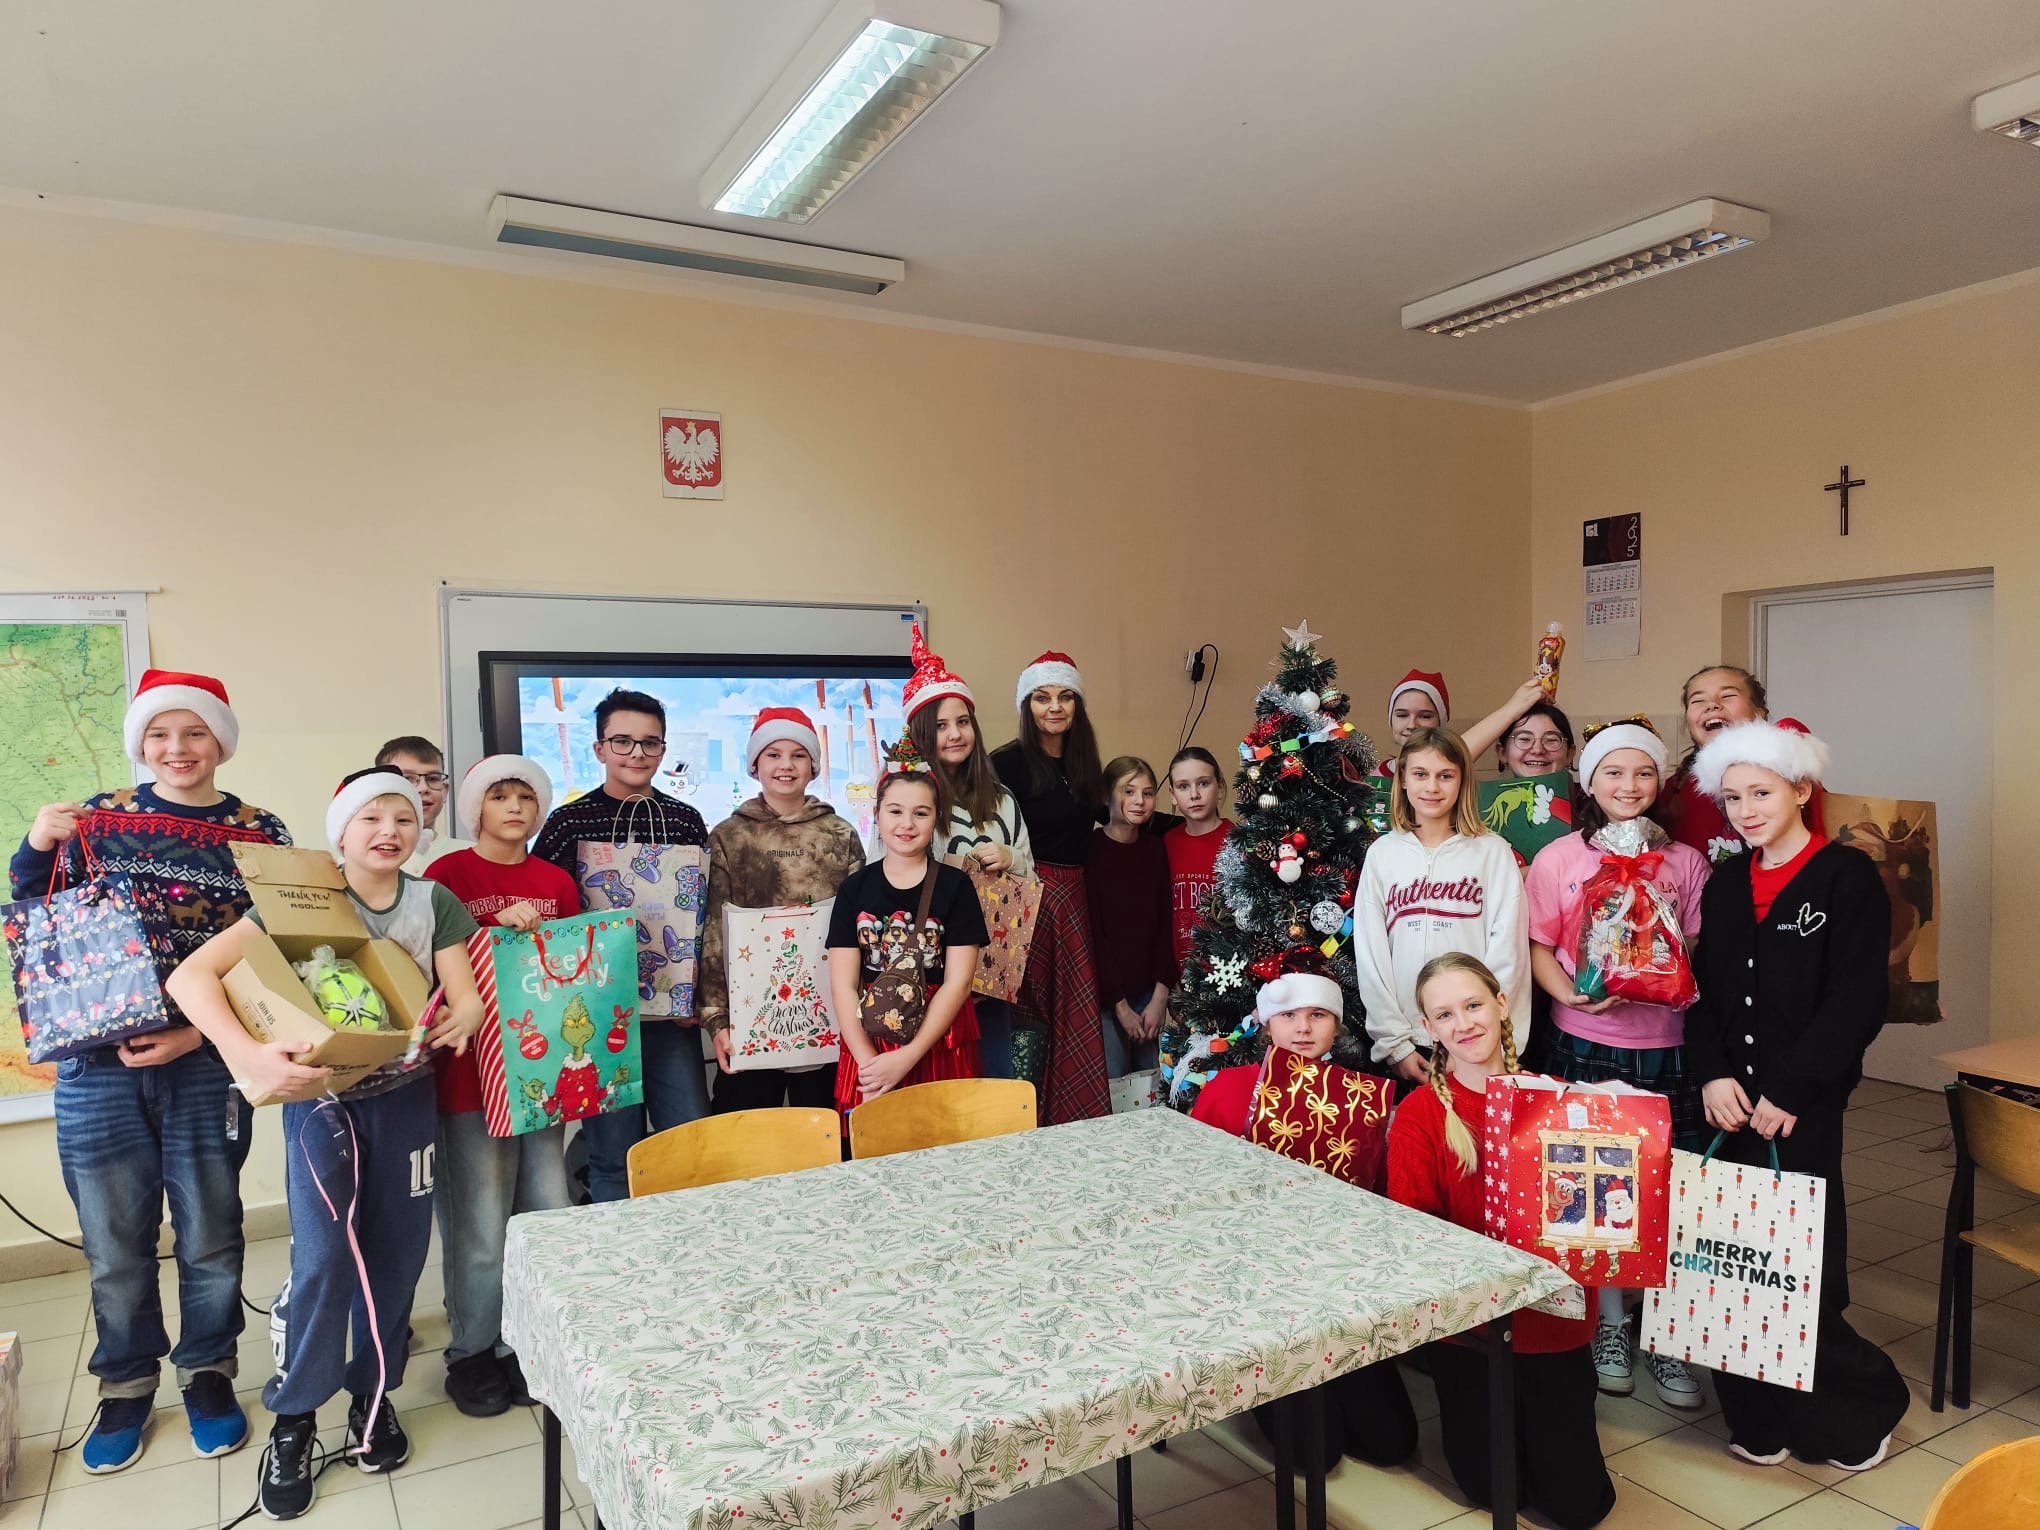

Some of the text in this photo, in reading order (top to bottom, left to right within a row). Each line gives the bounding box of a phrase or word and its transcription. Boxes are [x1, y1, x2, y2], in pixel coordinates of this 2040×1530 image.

[1626, 516, 1638, 557] 2025
[766, 849, 804, 858] ORIGINALS
[1385, 875, 1483, 913] Authentic
[1432, 920, 1453, 929] COAST
[257, 1000, 276, 1025] JOIN US
[770, 1003, 808, 1020] Merry
[768, 1016, 815, 1037] Christmas
[1695, 1237, 1772, 1268] MERRY
[1669, 1250, 1797, 1292] CHRISTMAS
